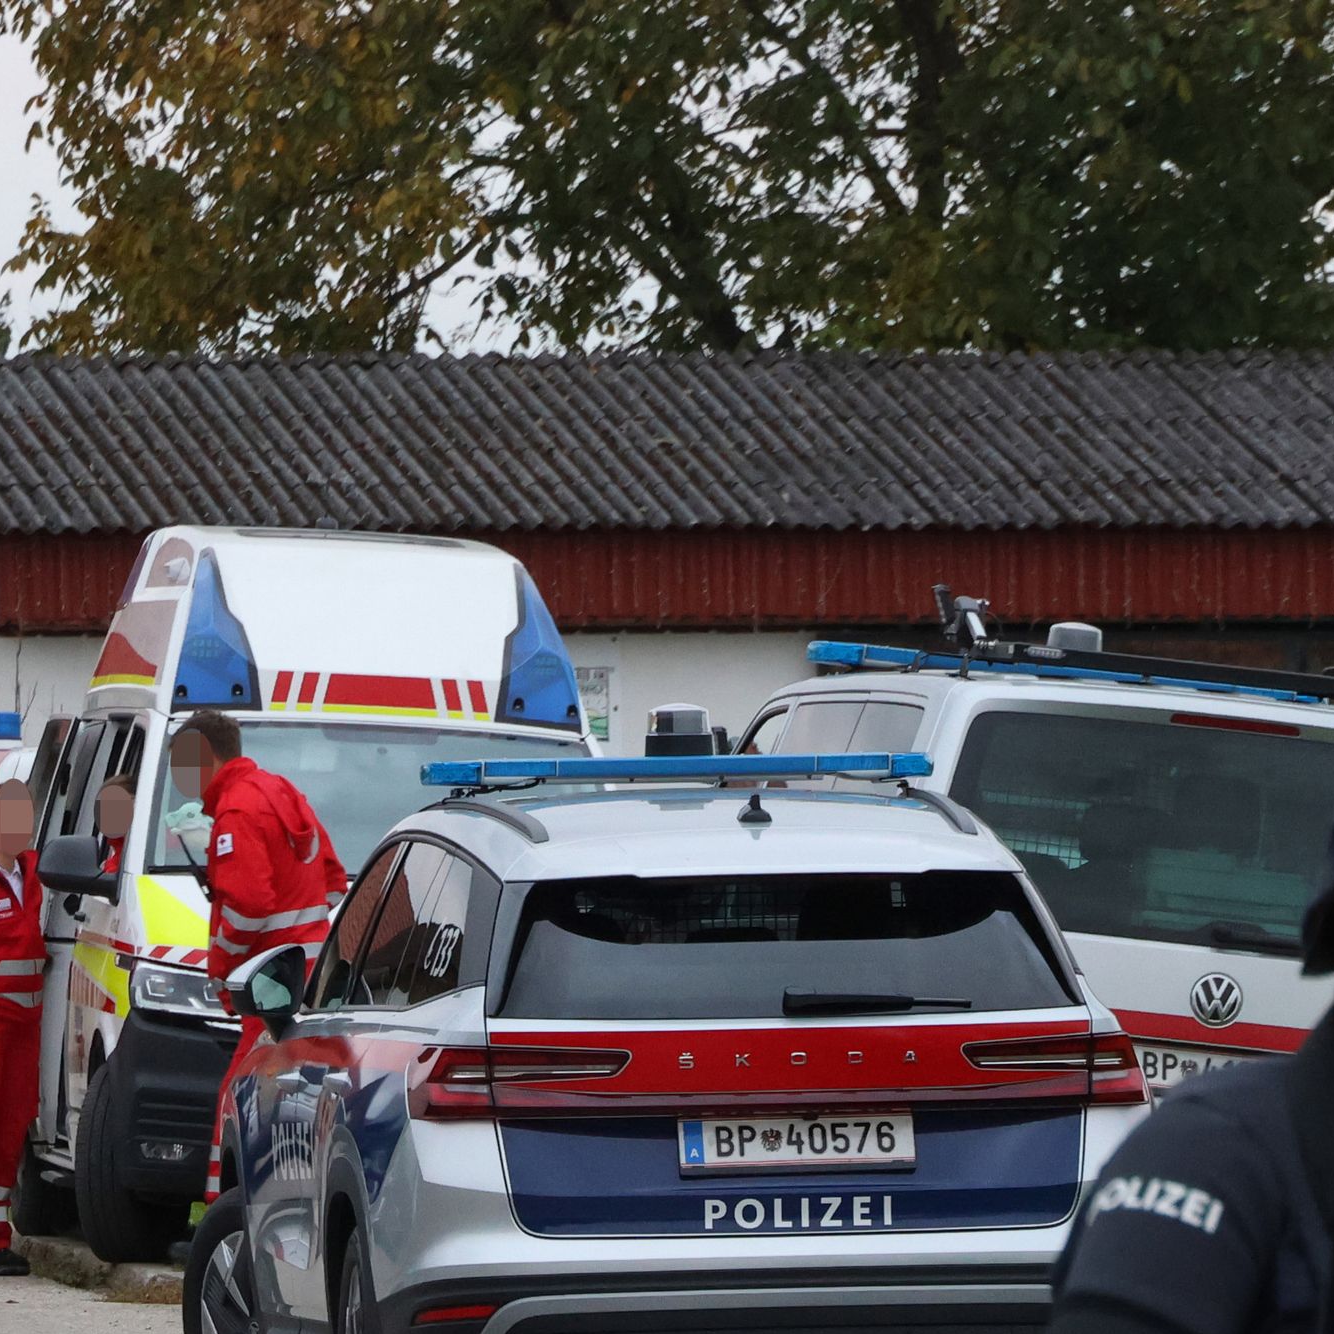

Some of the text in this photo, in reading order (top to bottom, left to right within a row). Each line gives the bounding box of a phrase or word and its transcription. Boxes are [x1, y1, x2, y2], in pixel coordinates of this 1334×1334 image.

[429, 927, 460, 978] 133
[1142, 1051, 1178, 1081] BP
[690, 1120, 896, 1158] A BP 40576
[704, 1195, 893, 1230] POLIZEI
